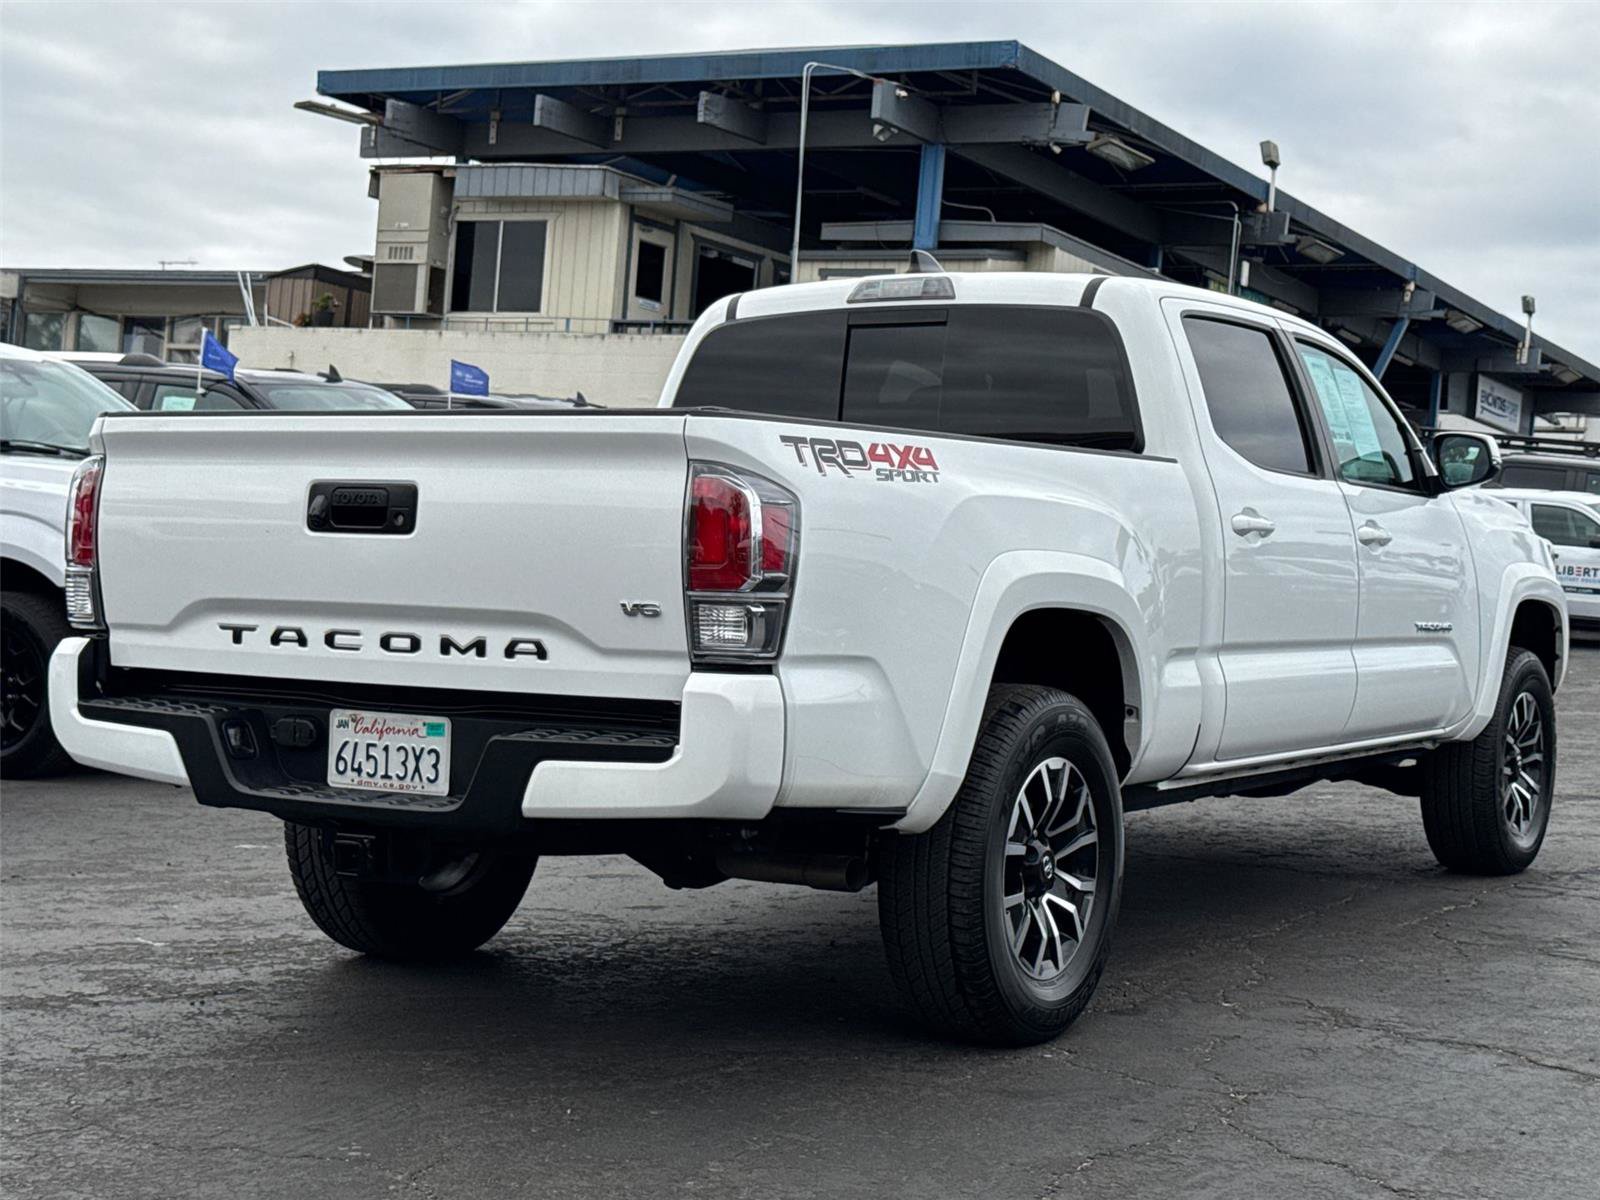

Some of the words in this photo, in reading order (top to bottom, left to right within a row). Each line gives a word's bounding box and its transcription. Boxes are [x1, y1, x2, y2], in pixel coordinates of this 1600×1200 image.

[779, 435, 872, 478] TRD
[875, 468, 940, 483] SPORT
[619, 602, 662, 618] V6
[218, 623, 548, 661] TACOMA
[336, 719, 349, 729] JAN
[353, 716, 428, 741] California
[335, 740, 441, 784] 64513X3
[357, 779, 418, 790] dmv.ca.gov
